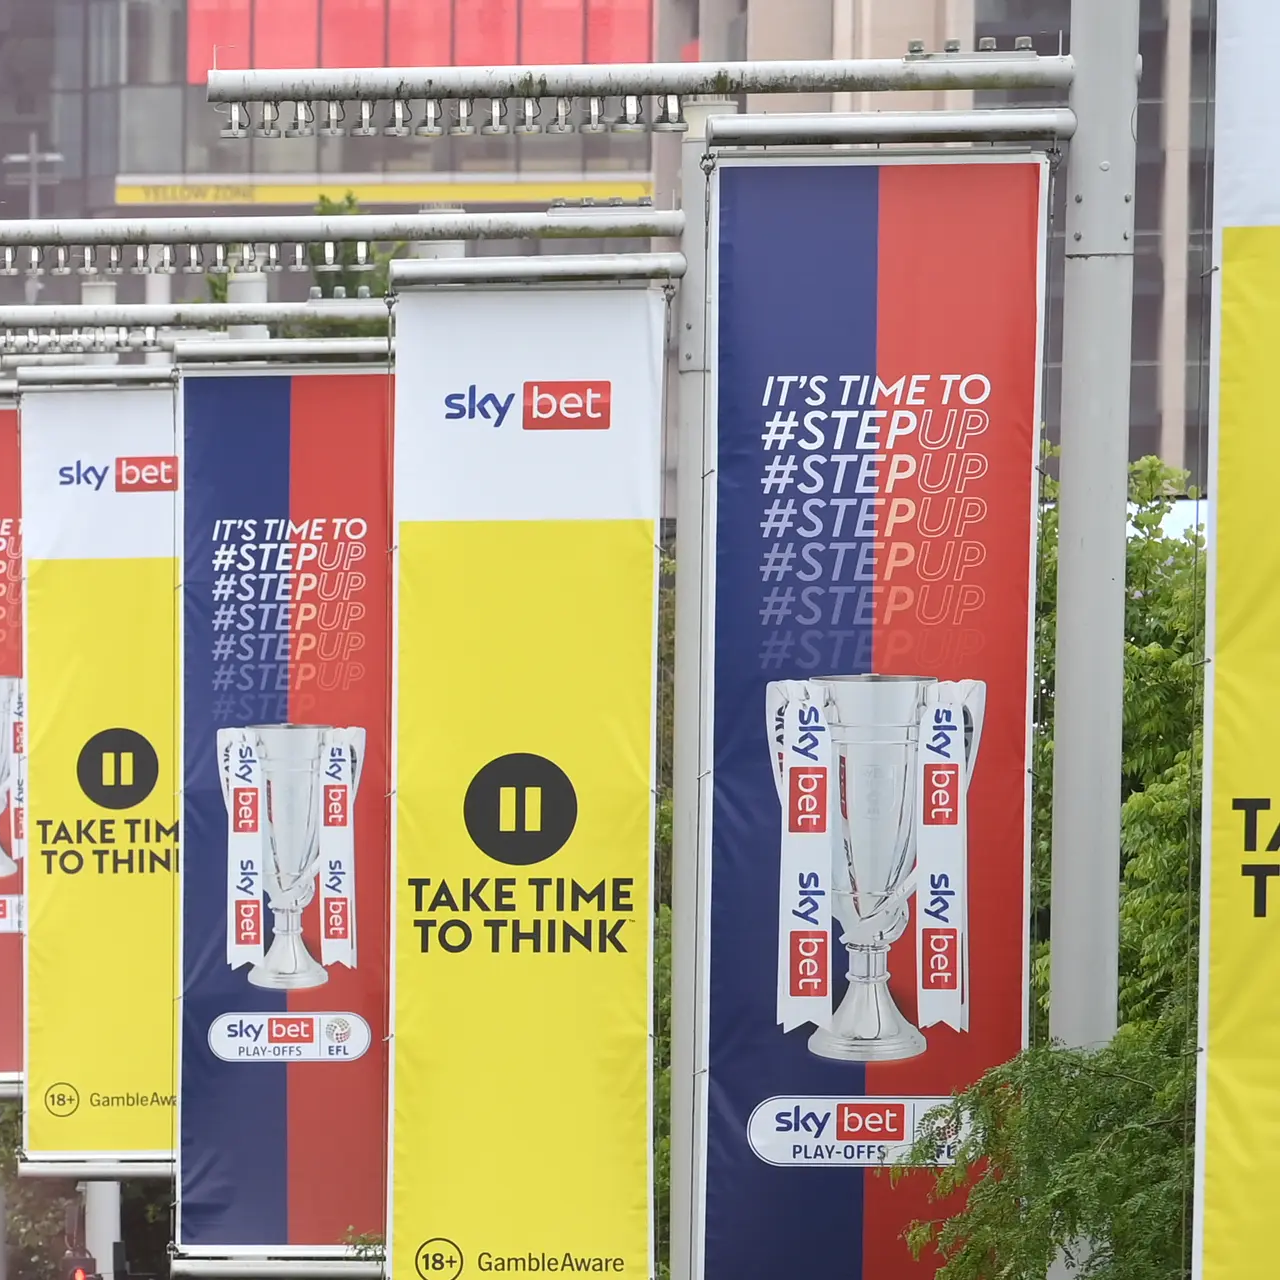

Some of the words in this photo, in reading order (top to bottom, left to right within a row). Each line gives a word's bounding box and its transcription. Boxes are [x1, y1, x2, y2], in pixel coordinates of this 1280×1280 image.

[444, 384, 516, 428] sky
[531, 385, 602, 419] bet
[761, 375, 829, 407] IT'S
[839, 374, 931, 407] TIME
[939, 373, 992, 405] TO
[760, 408, 989, 451] #STEPUP
[58, 460, 110, 492] sky
[121, 460, 173, 485] bet
[759, 452, 989, 495] #STEPUP
[211, 519, 258, 542] IT'S
[263, 518, 327, 541] TIME
[332, 517, 368, 541] TO
[759, 496, 988, 539] #STEPUP
[211, 541, 367, 572] #STEPUP
[759, 540, 988, 582] #STEPUP
[211, 571, 367, 602] #STEPUP
[211, 601, 367, 632] #STEPUP
[759, 584, 987, 626] #STEPUP
[211, 631, 367, 662] #STEPUP
[792, 705, 831, 763] sky
[925, 707, 964, 760] sky
[235, 744, 257, 784] sky
[325, 747, 346, 782] sky
[238, 791, 256, 829] bet
[327, 788, 346, 823] bet
[797, 772, 824, 829] bet
[927, 769, 956, 820] bet
[36, 819, 116, 845] TAKE
[40, 849, 84, 875] TO
[236, 859, 259, 896] sky
[325, 858, 346, 893] sky
[407, 877, 517, 912] TAKE
[528, 877, 634, 912] TIME
[792, 871, 826, 926] sky
[923, 873, 956, 926] sky
[240, 904, 259, 941] bet
[328, 901, 346, 935] bet
[413, 918, 473, 953] TO
[798, 937, 824, 992] bet
[928, 933, 955, 985] bet
[226, 1020, 264, 1042] sky
[271, 1019, 310, 1039] bet
[238, 1045, 302, 1057] PLAY-OFFS
[328, 1044, 349, 1056] EFL
[48, 1093, 76, 1107] 18+
[774, 1104, 831, 1139] sky
[843, 1106, 899, 1134] bet
[792, 1143, 887, 1161] PLAY-OFFS
[421, 1252, 458, 1271] 18+
